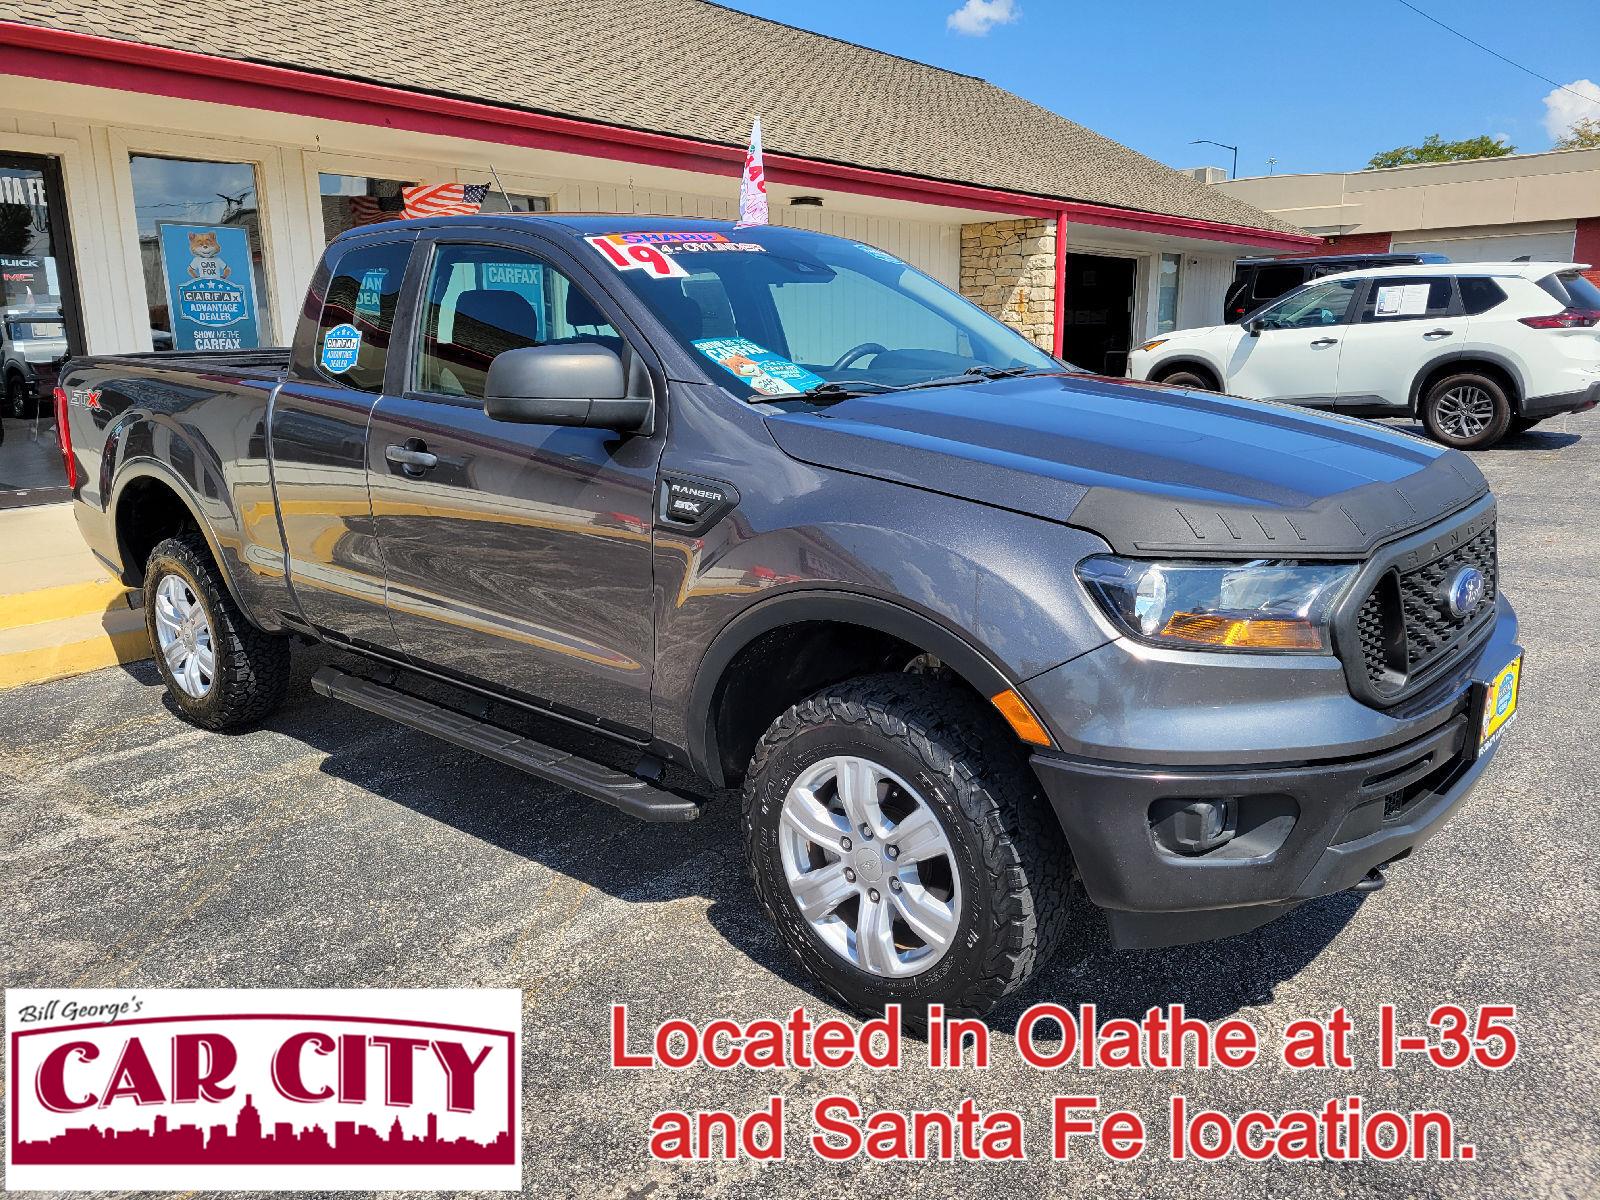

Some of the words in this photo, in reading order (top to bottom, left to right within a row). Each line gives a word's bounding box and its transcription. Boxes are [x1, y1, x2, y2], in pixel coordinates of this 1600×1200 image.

[27, 178, 48, 206] FE
[622, 232, 718, 244] SHARP
[592, 237, 671, 276] 19
[200, 261, 217, 269] CAR
[202, 268, 217, 276] FOX
[488, 266, 540, 285] CARFAX
[184, 291, 240, 302] CARFAX
[190, 303, 238, 312] ADVANTAGE
[199, 312, 231, 321] DEALER
[193, 330, 216, 339] SHOW
[216, 330, 227, 339] ME
[226, 330, 240, 339] THE
[194, 338, 242, 350] CARFAX
[326, 350, 354, 359] ADVANTAGE
[329, 359, 349, 368] DEALER
[70, 388, 103, 410] STX
[671, 484, 722, 501] RANGER
[673, 499, 700, 513] STX
